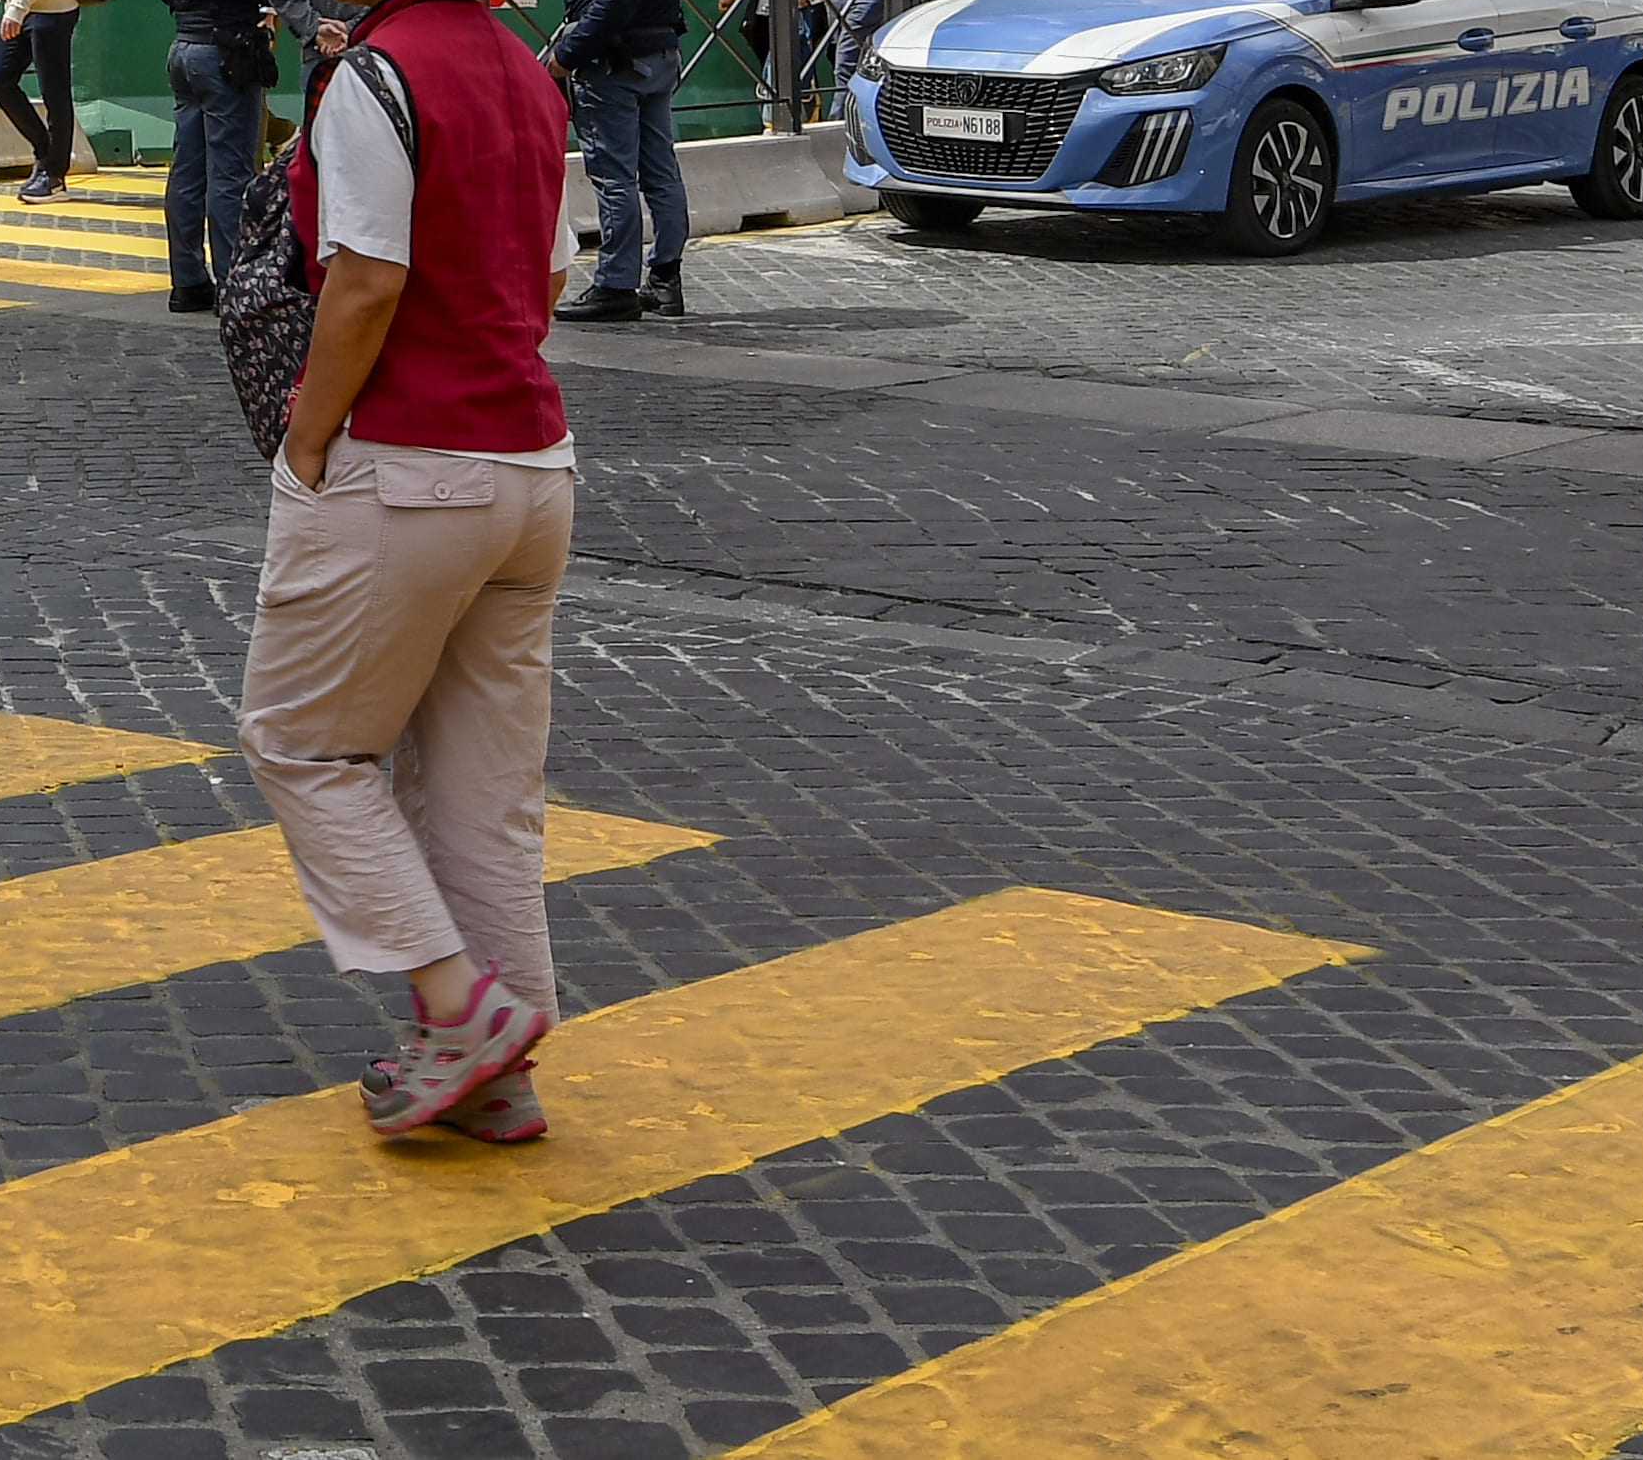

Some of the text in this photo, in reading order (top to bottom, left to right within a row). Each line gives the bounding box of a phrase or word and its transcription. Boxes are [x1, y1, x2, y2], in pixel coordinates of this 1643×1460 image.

[1381, 65, 1591, 131] POLIZIA
[926, 115, 1001, 136] POLIZIA N6188
